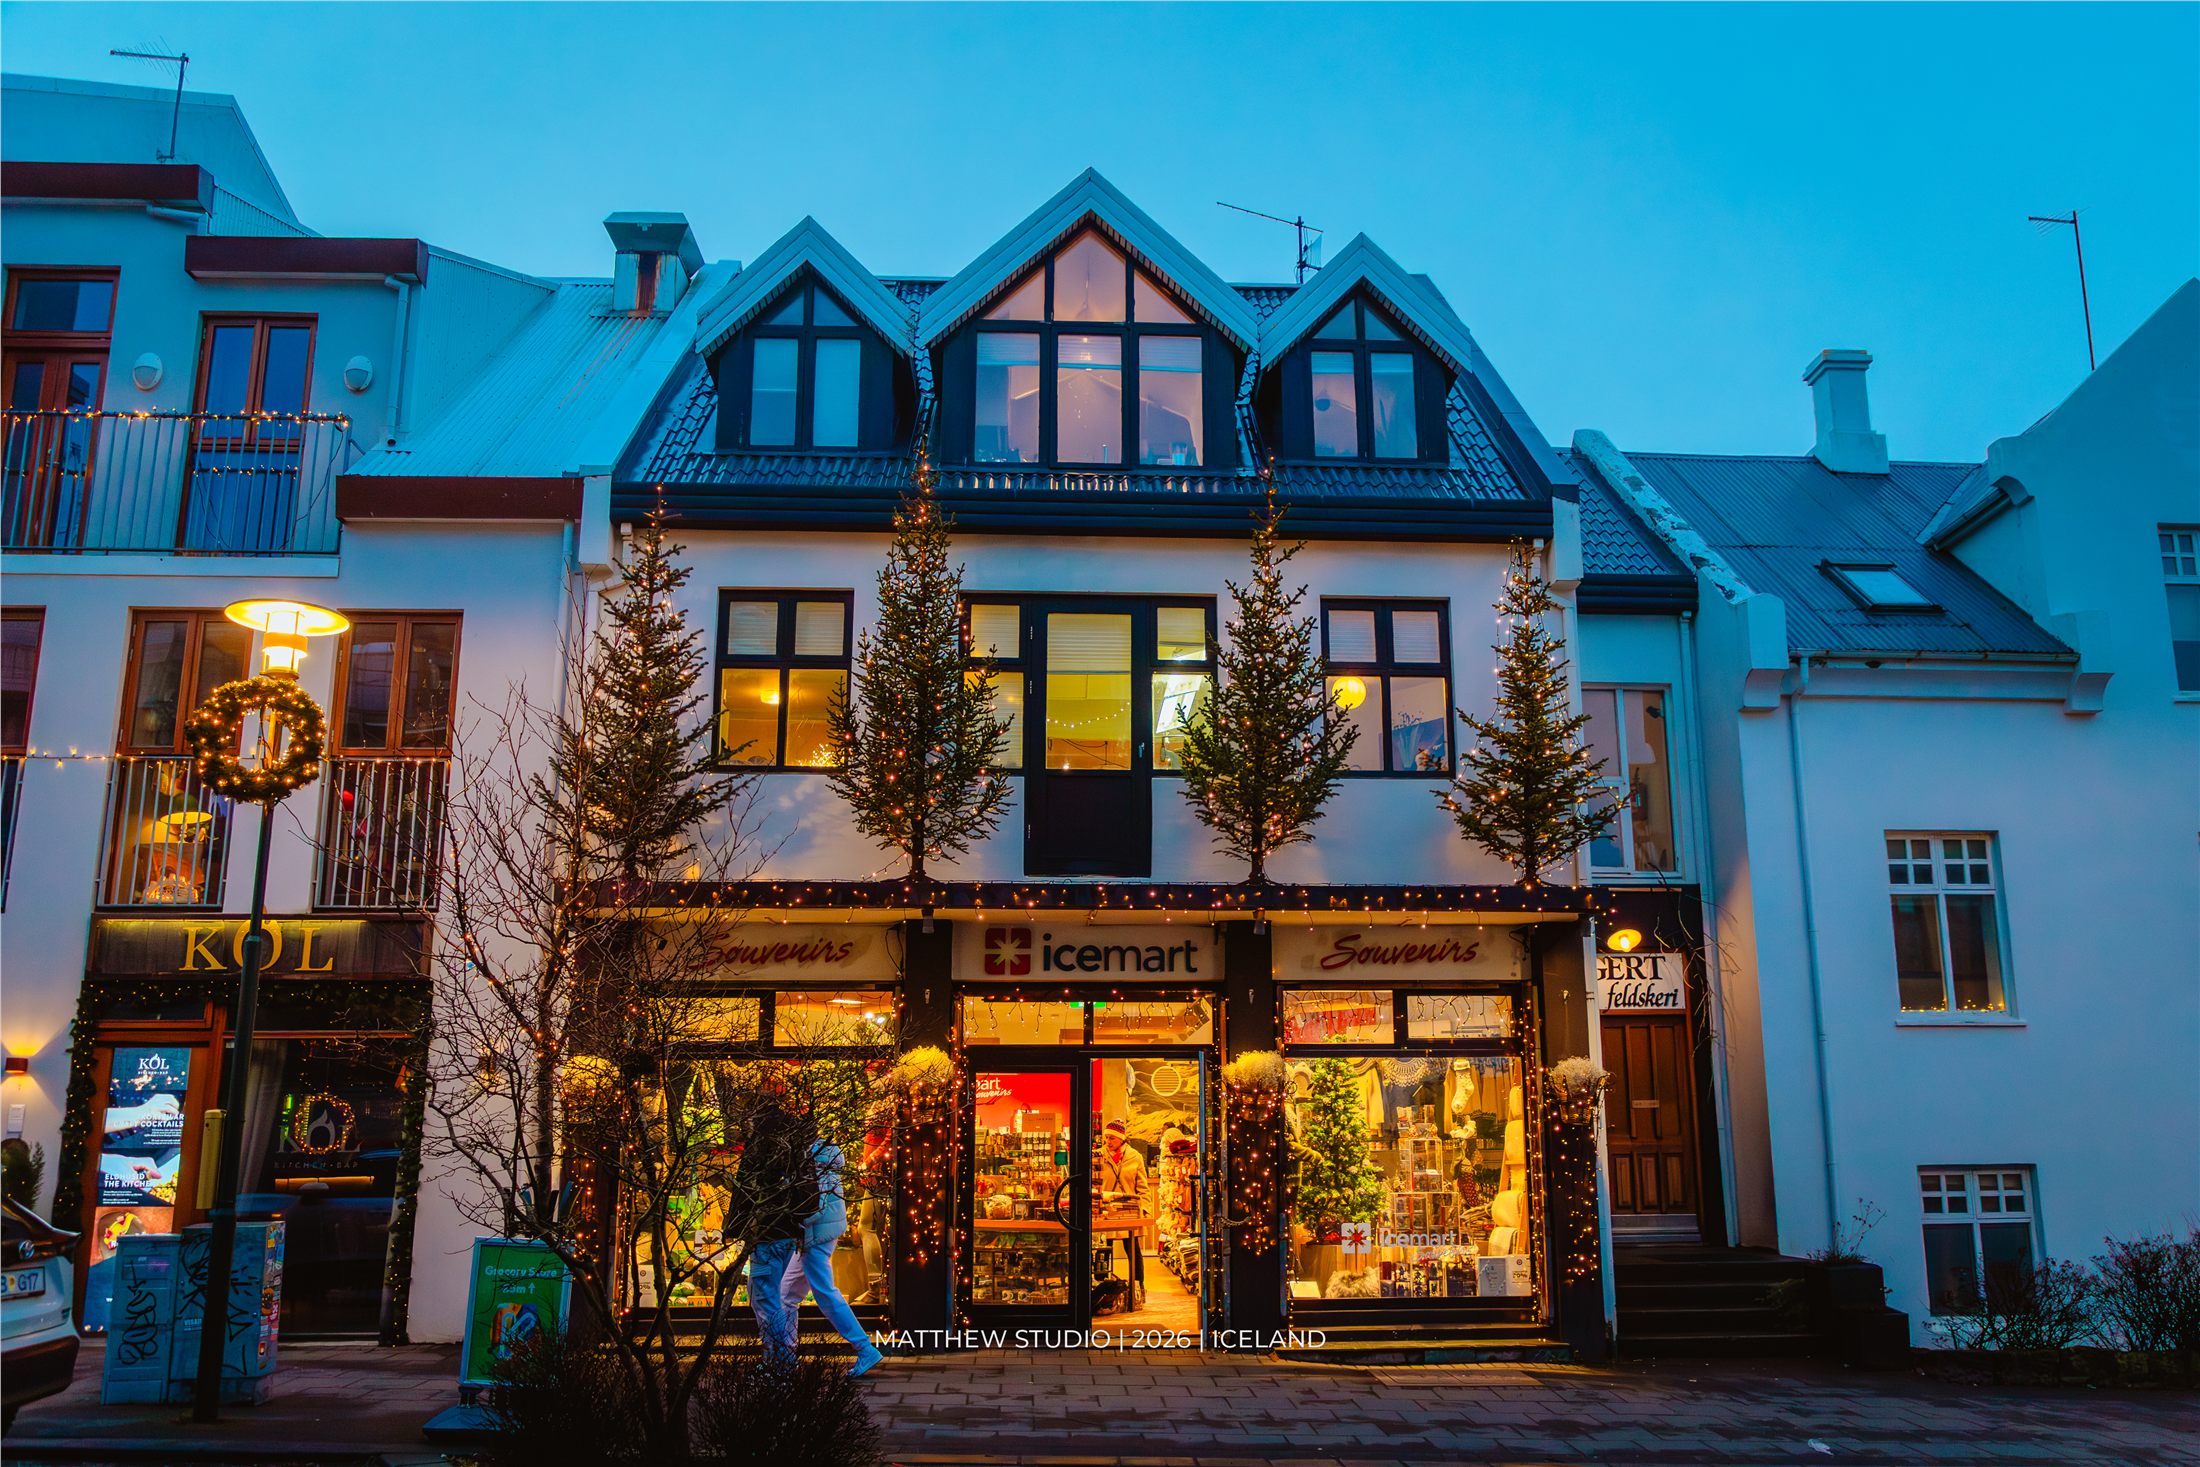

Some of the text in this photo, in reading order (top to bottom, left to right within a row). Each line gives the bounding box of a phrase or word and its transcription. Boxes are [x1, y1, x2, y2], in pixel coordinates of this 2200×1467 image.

[689, 933, 853, 970] Souvenirs
[1042, 933, 1198, 973] icemart
[1320, 934, 1480, 970] Souvenirs
[1602, 981, 1679, 1014] feldskeri
[140, 1120, 184, 1128] COCKTAILS
[103, 1180, 154, 1188] THE KITCHE
[1379, 1228, 1457, 1248] icemart
[18, 1272, 39, 1292] G17
